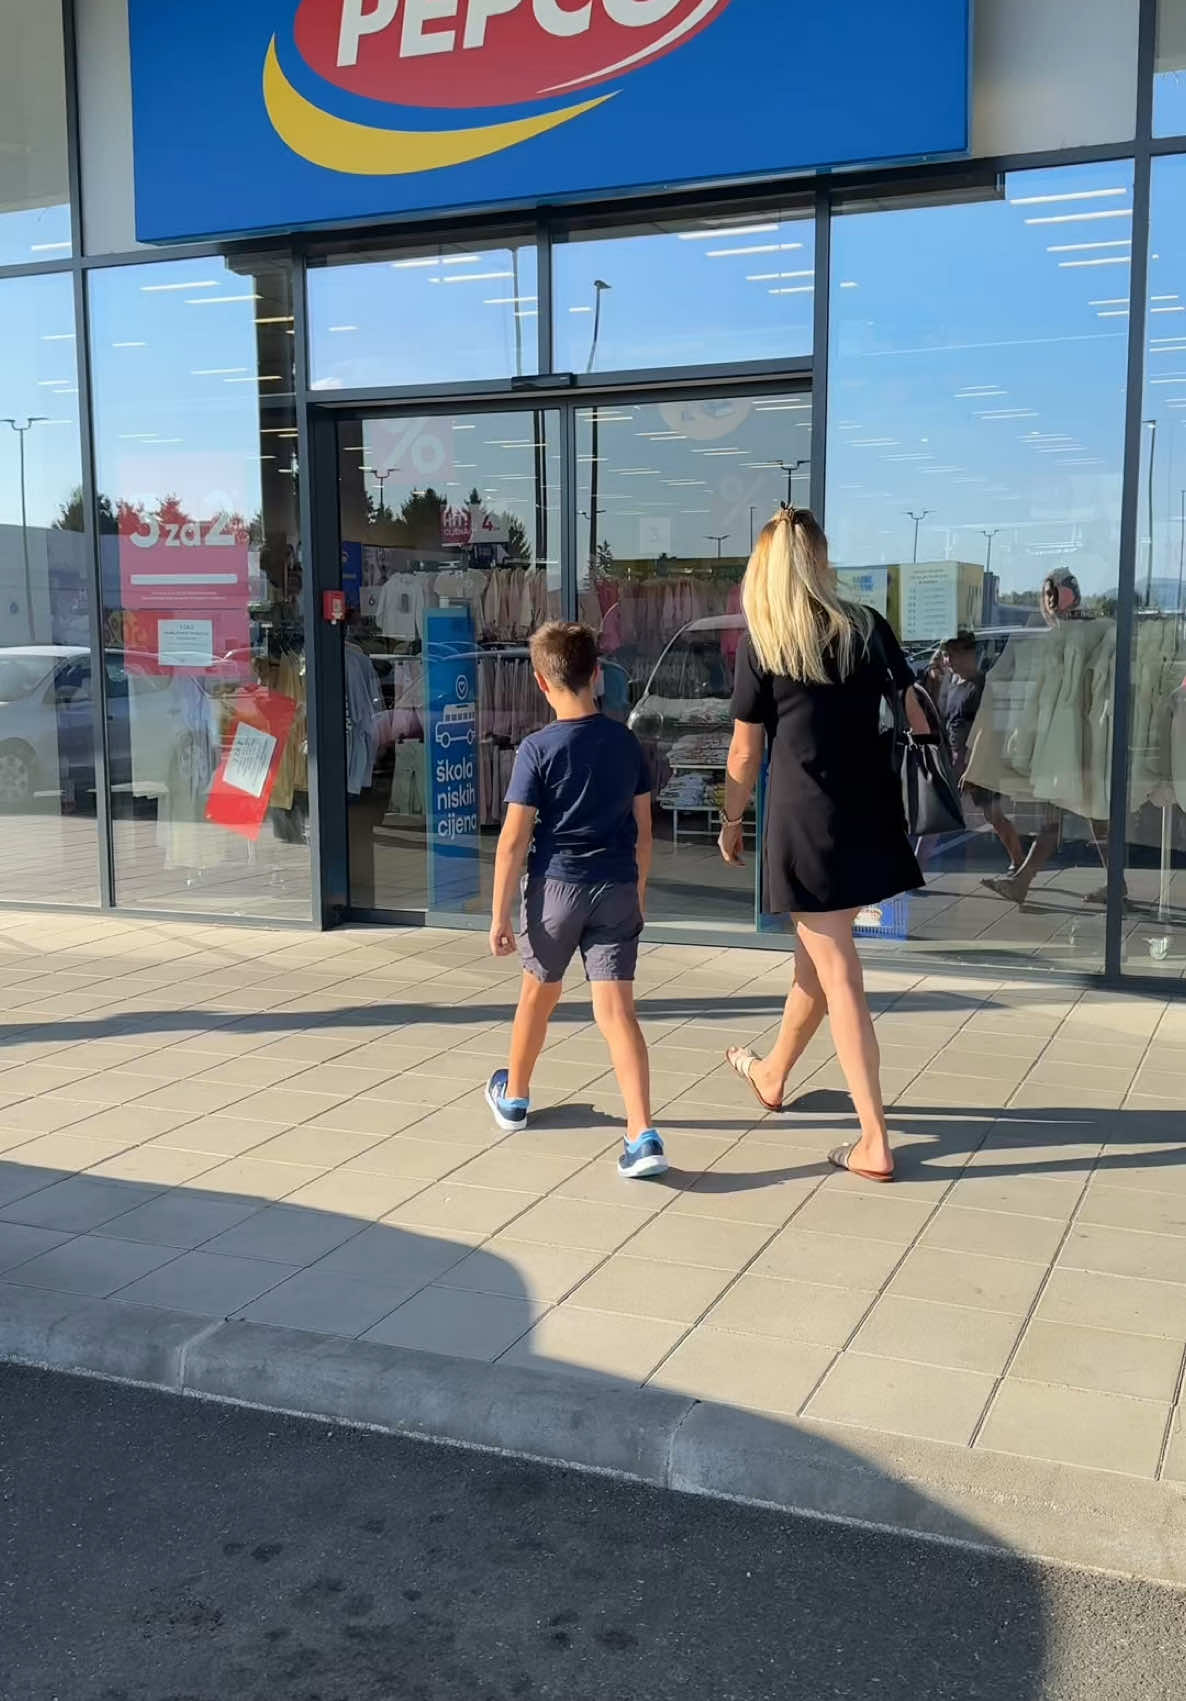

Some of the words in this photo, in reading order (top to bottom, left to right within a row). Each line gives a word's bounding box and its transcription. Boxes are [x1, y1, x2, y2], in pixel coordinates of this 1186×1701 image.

[336, 0, 683, 67] PEP
[164, 521, 201, 547] za
[436, 756, 474, 783] škola
[437, 782, 476, 811] niskih
